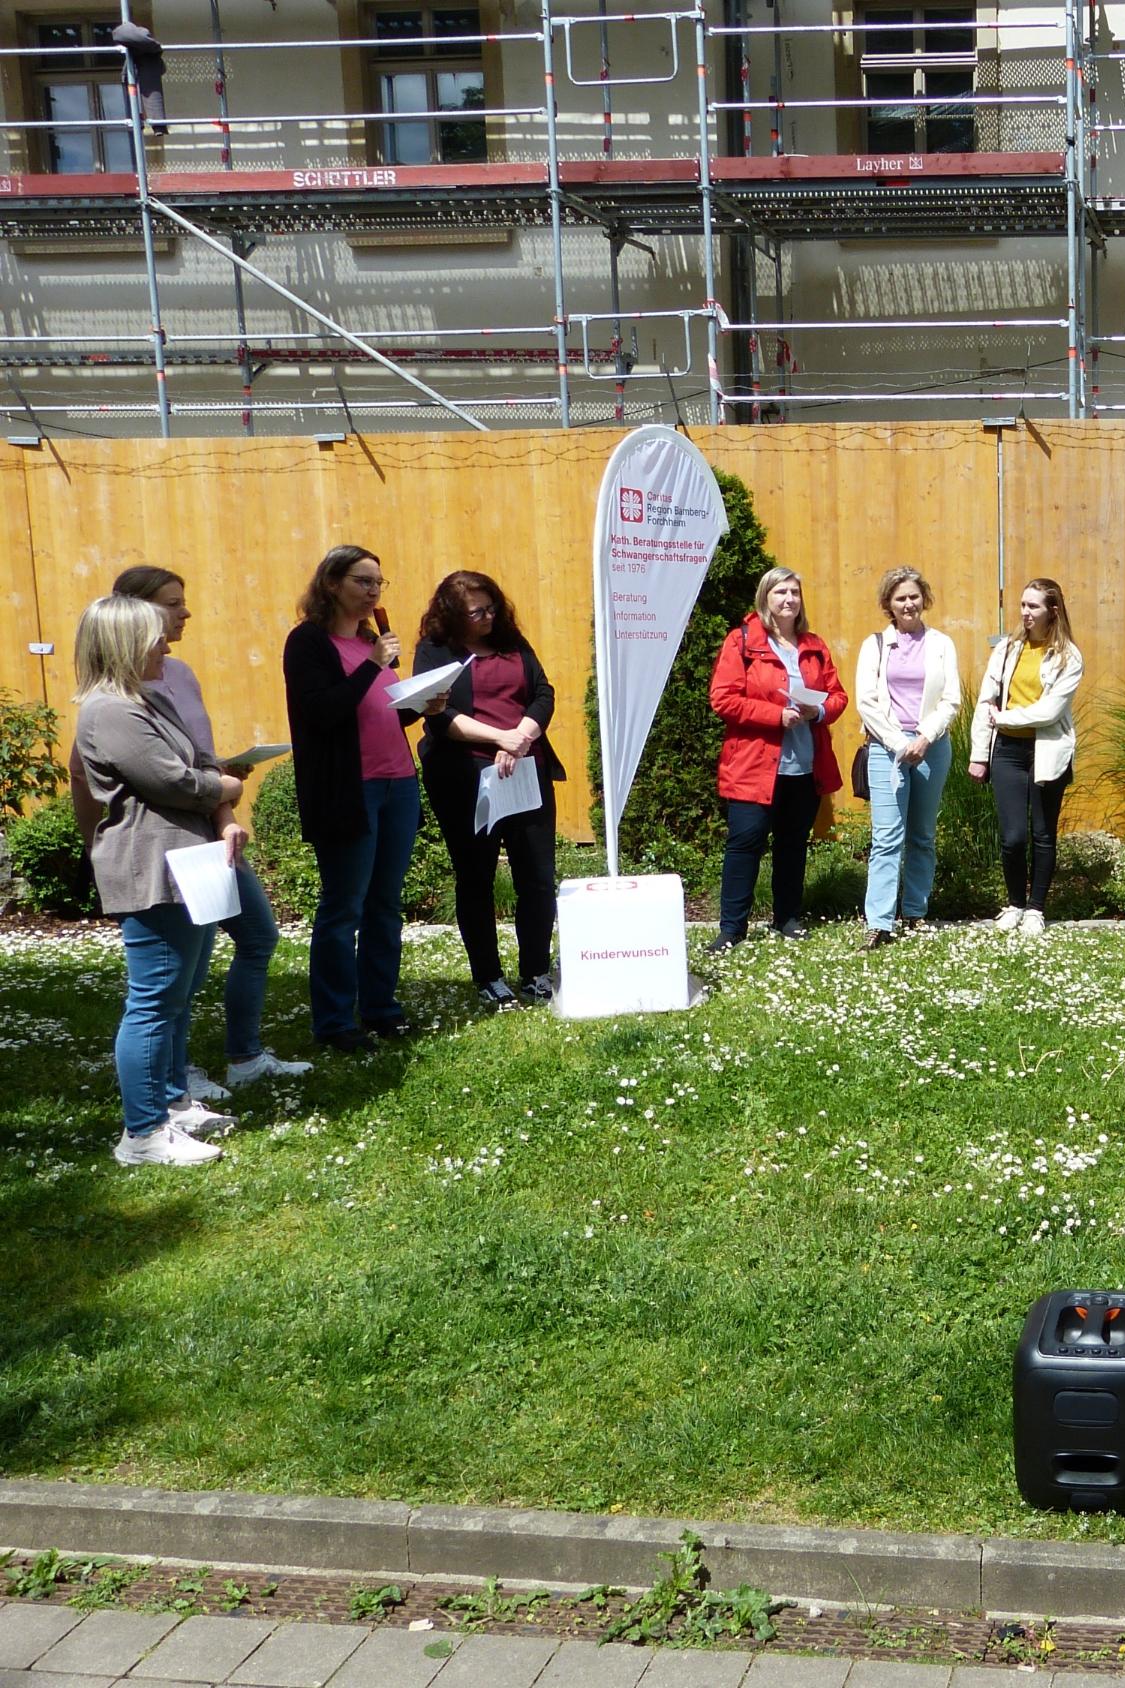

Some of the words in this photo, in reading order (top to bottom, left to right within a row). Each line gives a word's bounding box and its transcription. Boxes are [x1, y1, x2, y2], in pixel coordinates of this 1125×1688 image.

[856, 157, 903, 173] Layher
[674, 506, 709, 519] Bamberg-
[611, 534, 631, 545] Kath.
[633, 537, 693, 550] Beratungsstelle
[694, 541, 705, 550] für
[611, 548, 708, 564] Schwangerschaftsfragen
[612, 563, 625, 572] seit
[628, 563, 646, 573] 1976
[613, 592, 647, 604] Beratung
[613, 611, 656, 621] Information
[614, 629, 668, 641] Unterstützung
[581, 947, 669, 960] Kinderwunsch
